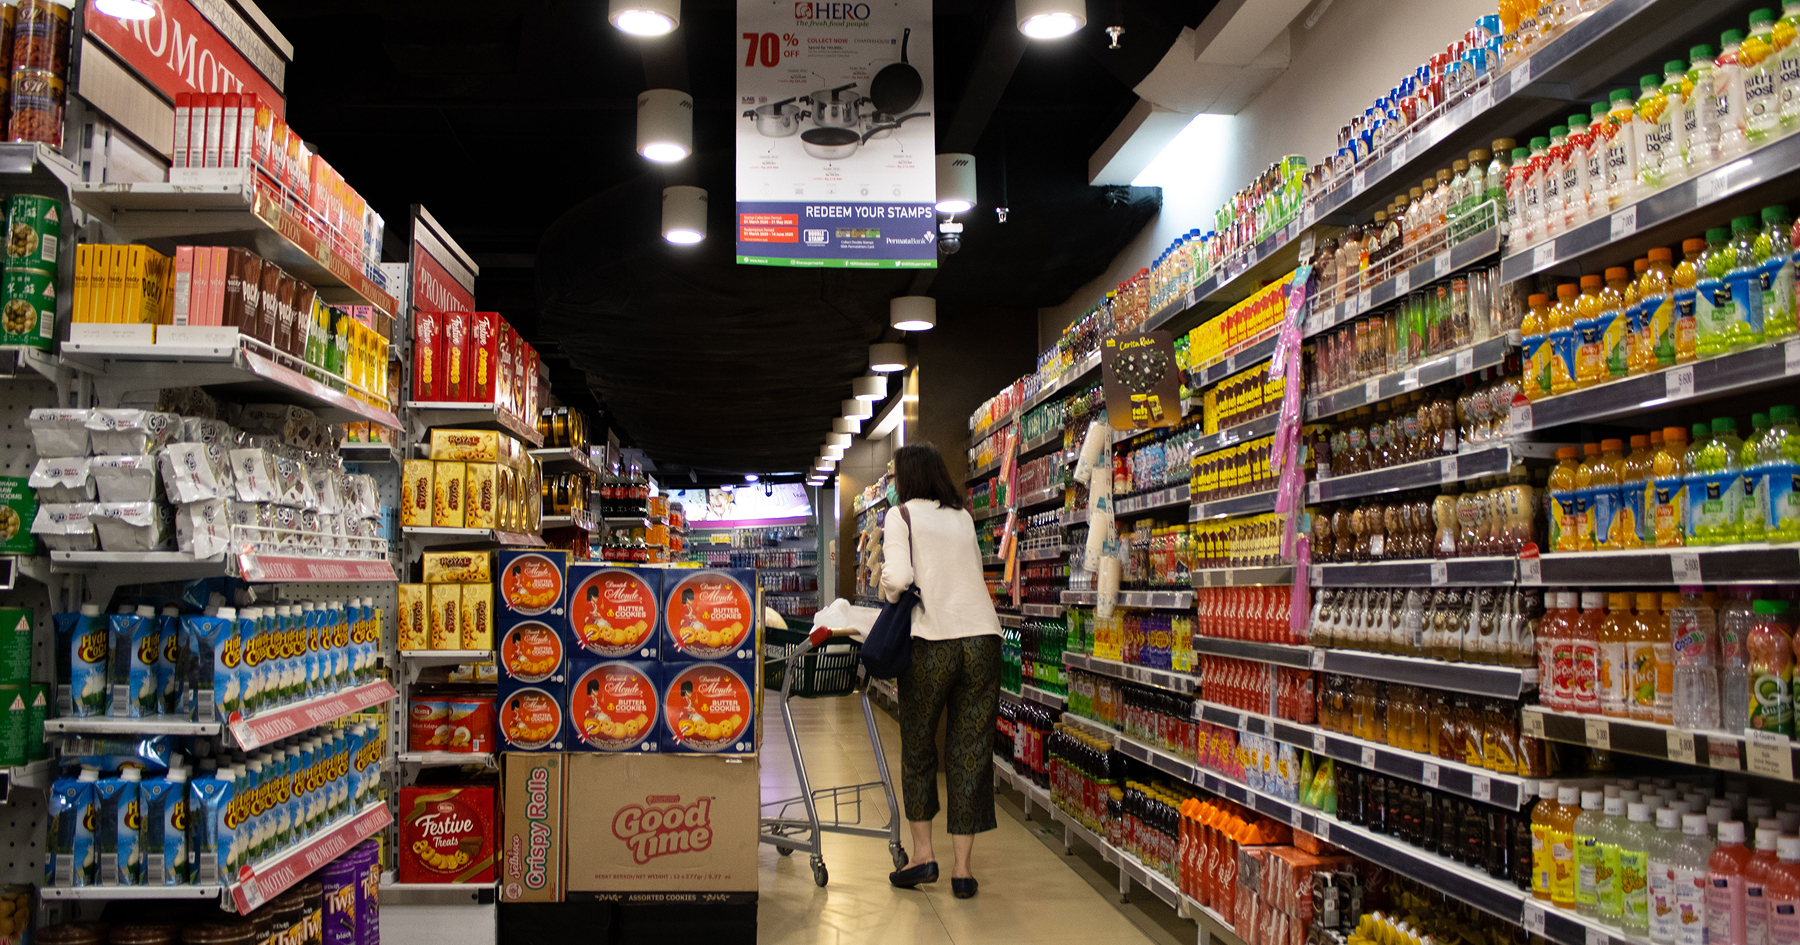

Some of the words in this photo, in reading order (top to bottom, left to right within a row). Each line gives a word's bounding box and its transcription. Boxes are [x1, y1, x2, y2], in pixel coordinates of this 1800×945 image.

[816, 2, 870, 20] HERO
[809, 20, 828, 28] fresh
[742, 32, 780, 68] 70
[784, 50, 800, 58] OFF
[1744, 74, 1772, 91] nutri
[1746, 83, 1774, 101] boost
[272, 140, 286, 168] Pocky
[806, 206, 852, 218] REDEEM
[855, 206, 884, 218] YOUR
[888, 206, 932, 218] STAMPS
[142, 277, 162, 305] Pocky
[242, 280, 260, 308] Pocky
[362, 280, 392, 310] PROMOTION
[262, 290, 278, 315] Pocky
[279, 301, 294, 326] Pocky
[423, 315, 434, 344] Festive
[451, 315, 462, 345] Festive
[479, 316, 490, 346] Festive
[1680, 320, 1696, 330] Pulpy
[1140, 336, 1155, 347] Rasa
[1583, 345, 1599, 356] Pulpy
[1132, 404, 1148, 416] teh
[450, 436, 479, 444] ROYAL
[418, 478, 427, 508] ROYAL
[451, 478, 460, 510] ROYAL
[483, 480, 492, 511] ROYAL
[1657, 507, 1673, 516] Pulpy
[307, 564, 348, 578] PROMOTION
[357, 565, 389, 578] PROMOTION
[441, 558, 470, 566] ROYAL
[604, 588, 640, 602] Monde
[699, 591, 735, 605] Monde
[414, 601, 423, 632] ROYAL
[447, 601, 456, 632] ROYAL
[478, 601, 486, 632] ROYAL
[355, 686, 391, 705] PROMOTION
[604, 682, 641, 696] Monde
[698, 683, 734, 696] Monde
[305, 702, 349, 722] PROMOTION
[528, 768, 548, 820] Rolls
[354, 810, 387, 837] PROMOTION
[415, 813, 474, 838] Festive
[614, 797, 711, 838] Good
[305, 834, 347, 868] PROMOTION
[433, 836, 458, 848] Treats
[628, 826, 713, 865] Time
[526, 820, 550, 889] Crispy
[336, 931, 352, 940] black
